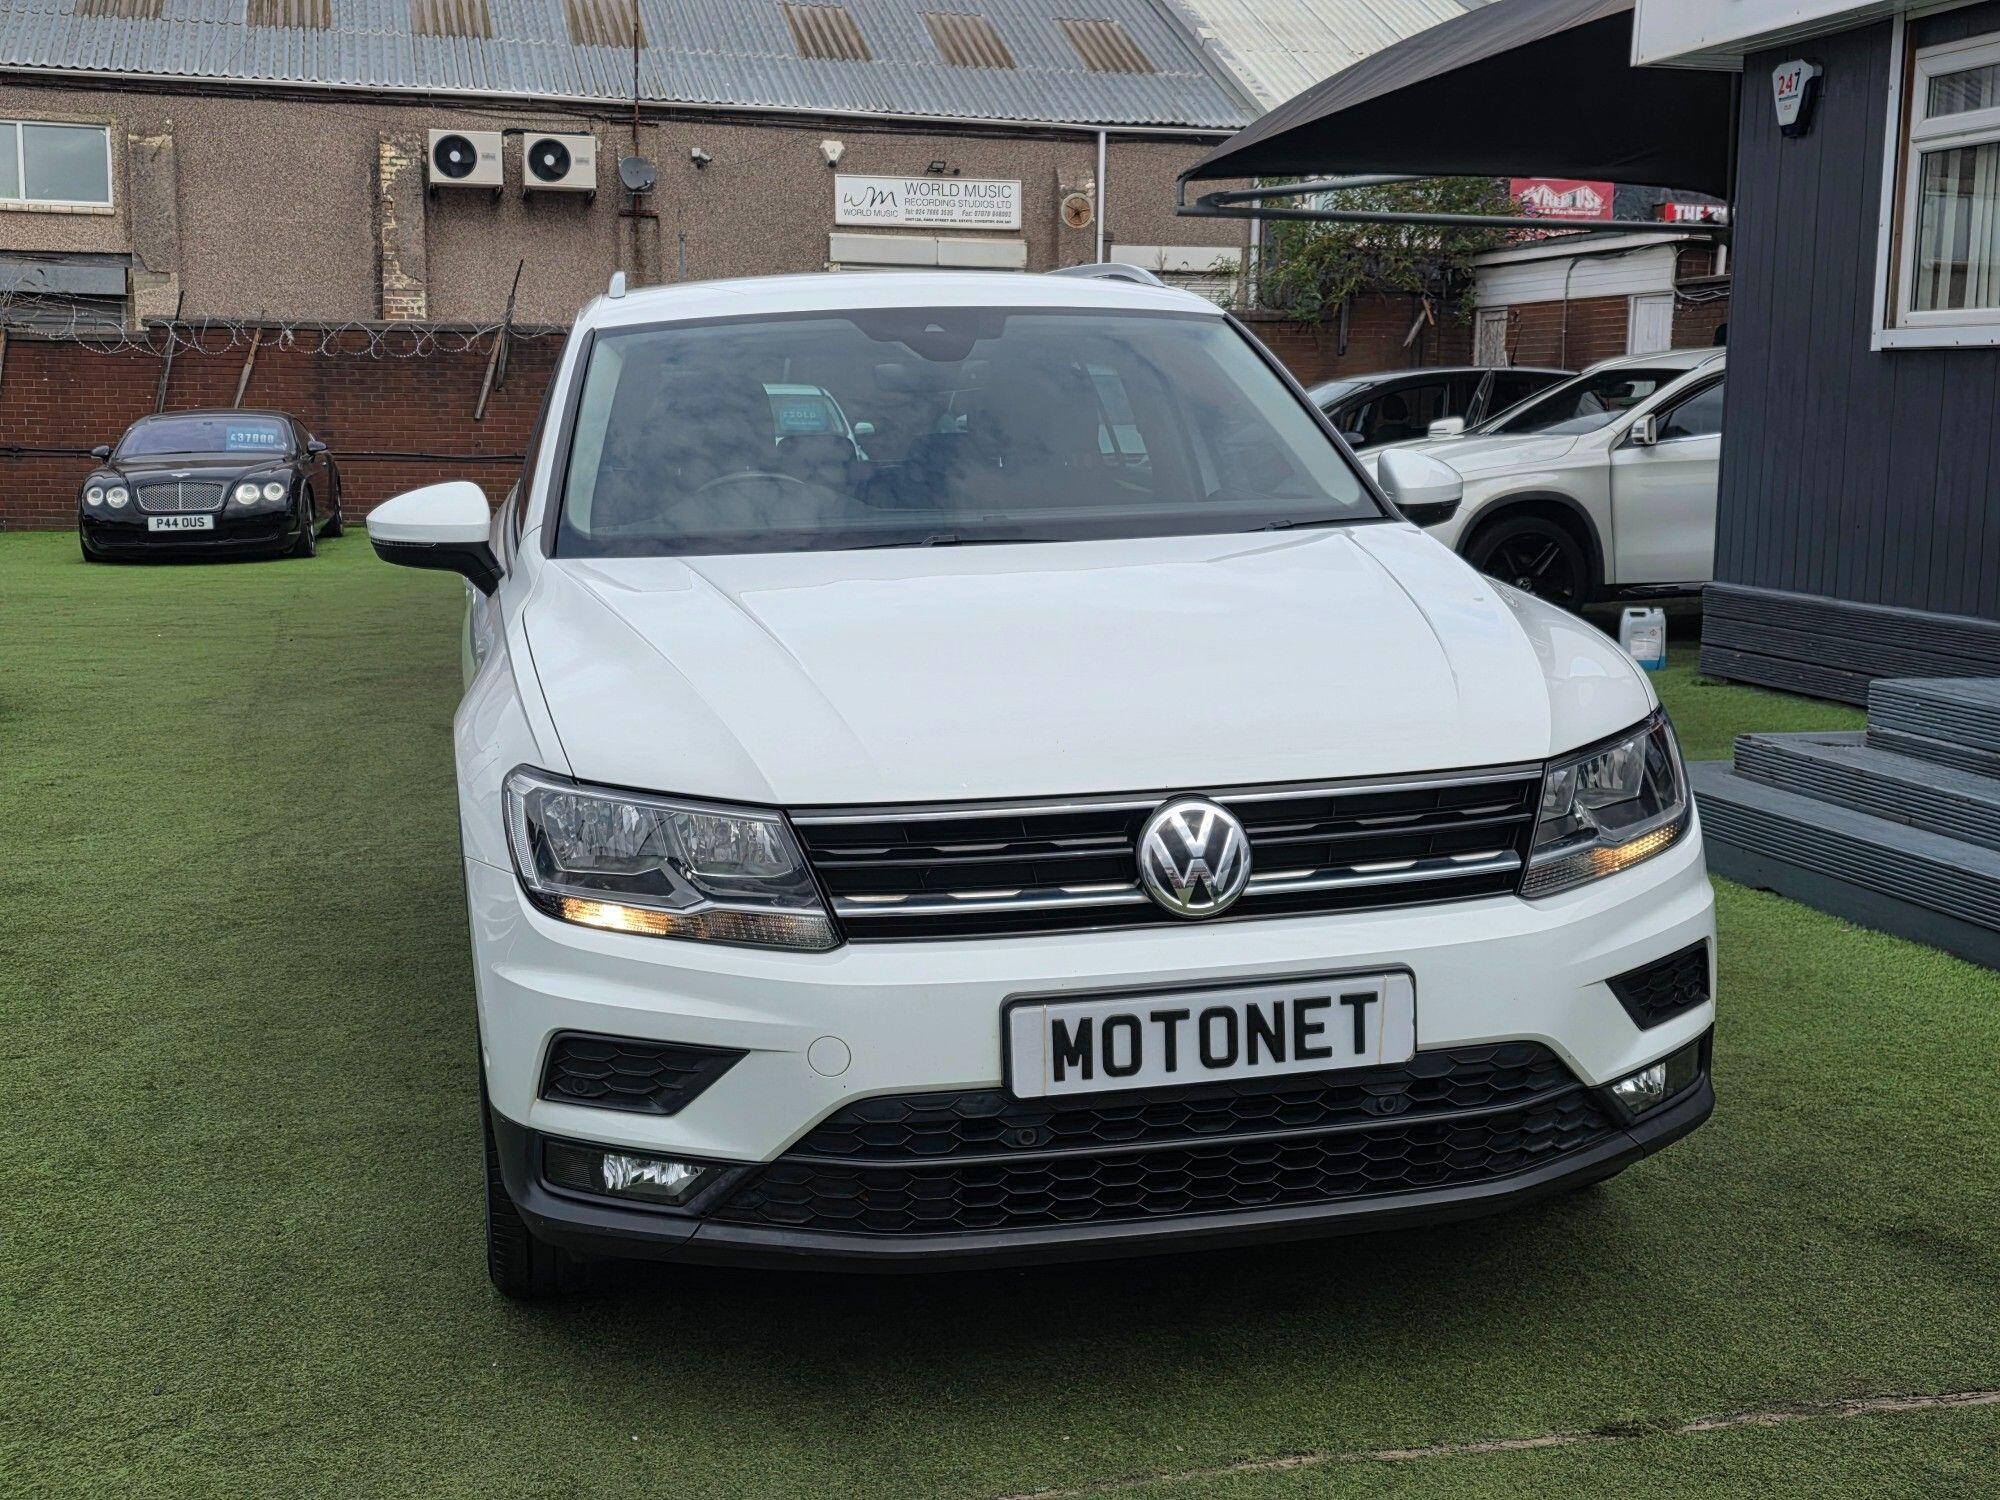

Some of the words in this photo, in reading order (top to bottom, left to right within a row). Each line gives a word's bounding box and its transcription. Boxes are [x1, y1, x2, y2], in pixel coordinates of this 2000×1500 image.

[904, 182, 960, 197] WORLD
[964, 184, 1012, 199] MUSIC
[904, 197, 956, 208] RECORDING
[958, 199, 995, 209] STUDIOS
[997, 200, 1012, 209] LTD
[843, 208, 872, 217] WORLD
[873, 209, 899, 218] MUSIC
[156, 518, 179, 528] P44
[1051, 990, 1379, 1082] MOTONET
